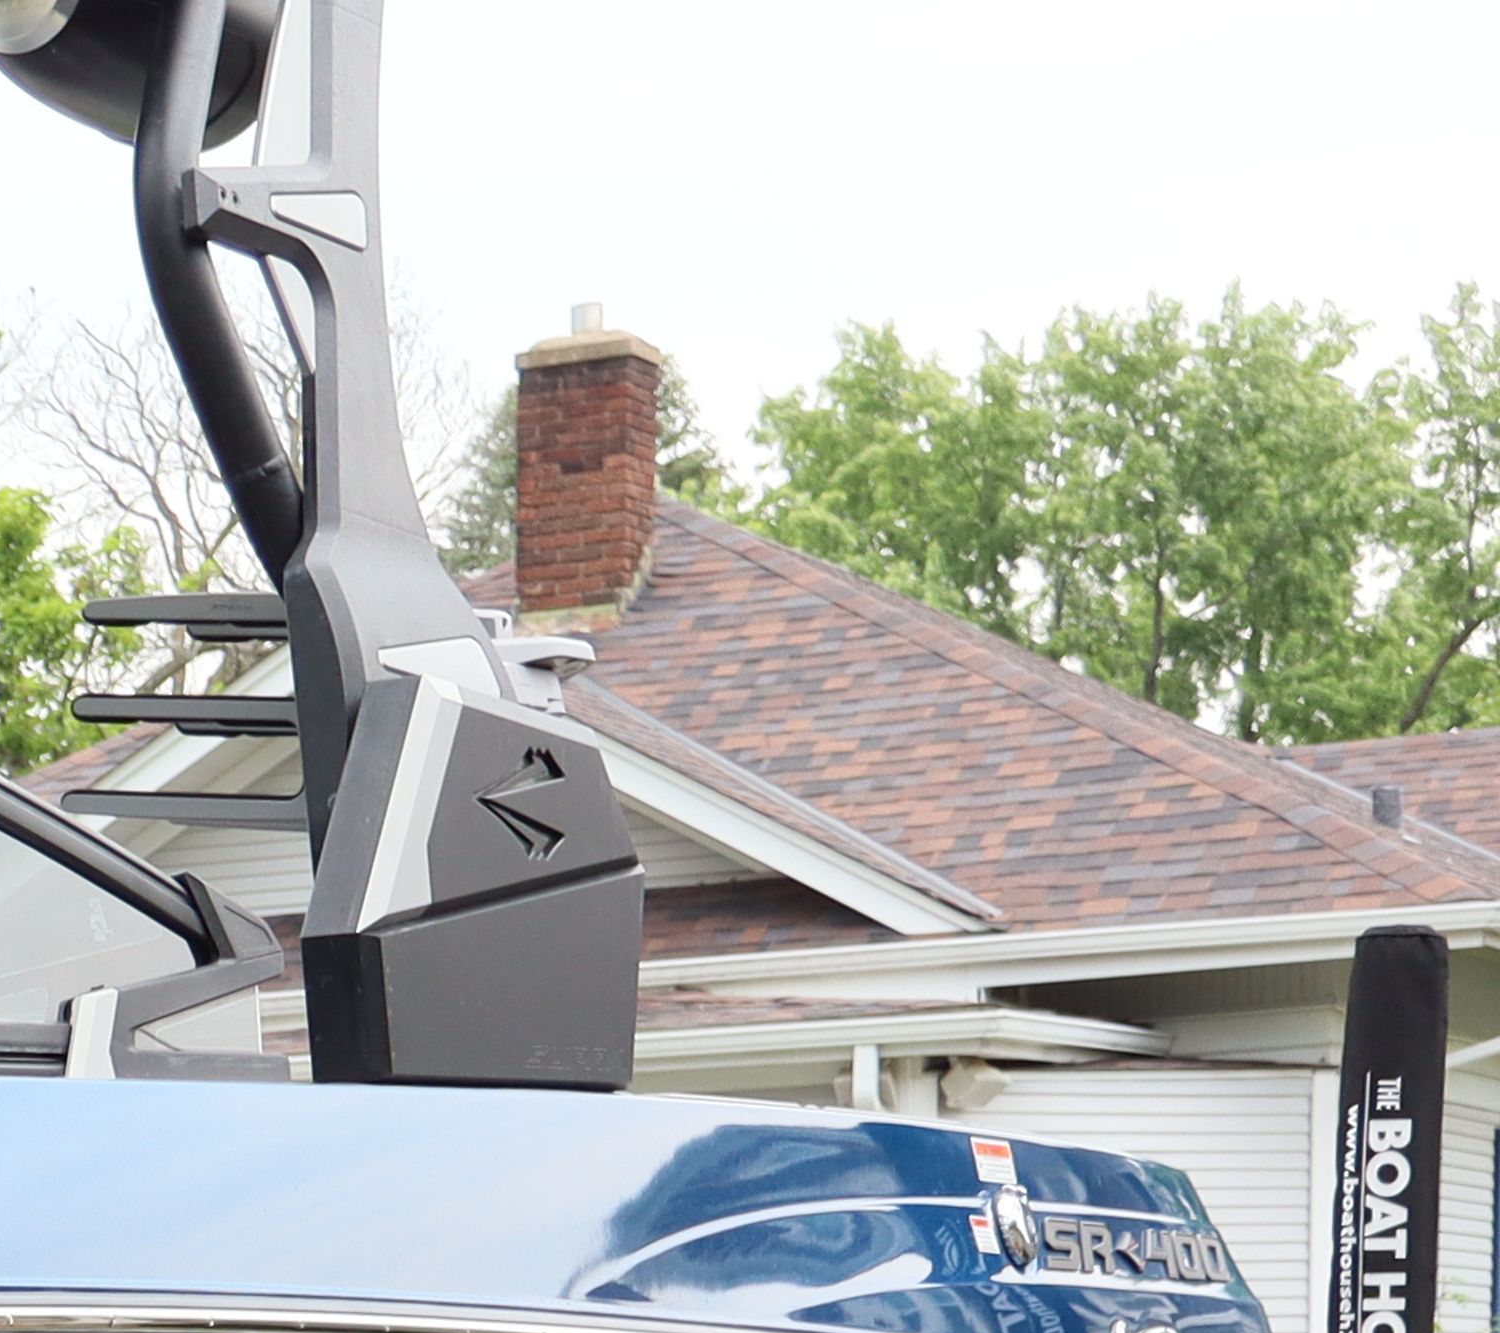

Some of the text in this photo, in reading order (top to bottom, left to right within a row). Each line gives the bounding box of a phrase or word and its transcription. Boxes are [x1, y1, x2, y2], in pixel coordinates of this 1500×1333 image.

[1376, 1076, 1402, 1111] THE
[1364, 1118, 1412, 1260] BOAT
[1043, 1216, 1116, 1274] SR
[1142, 1227, 1232, 1283] 400
